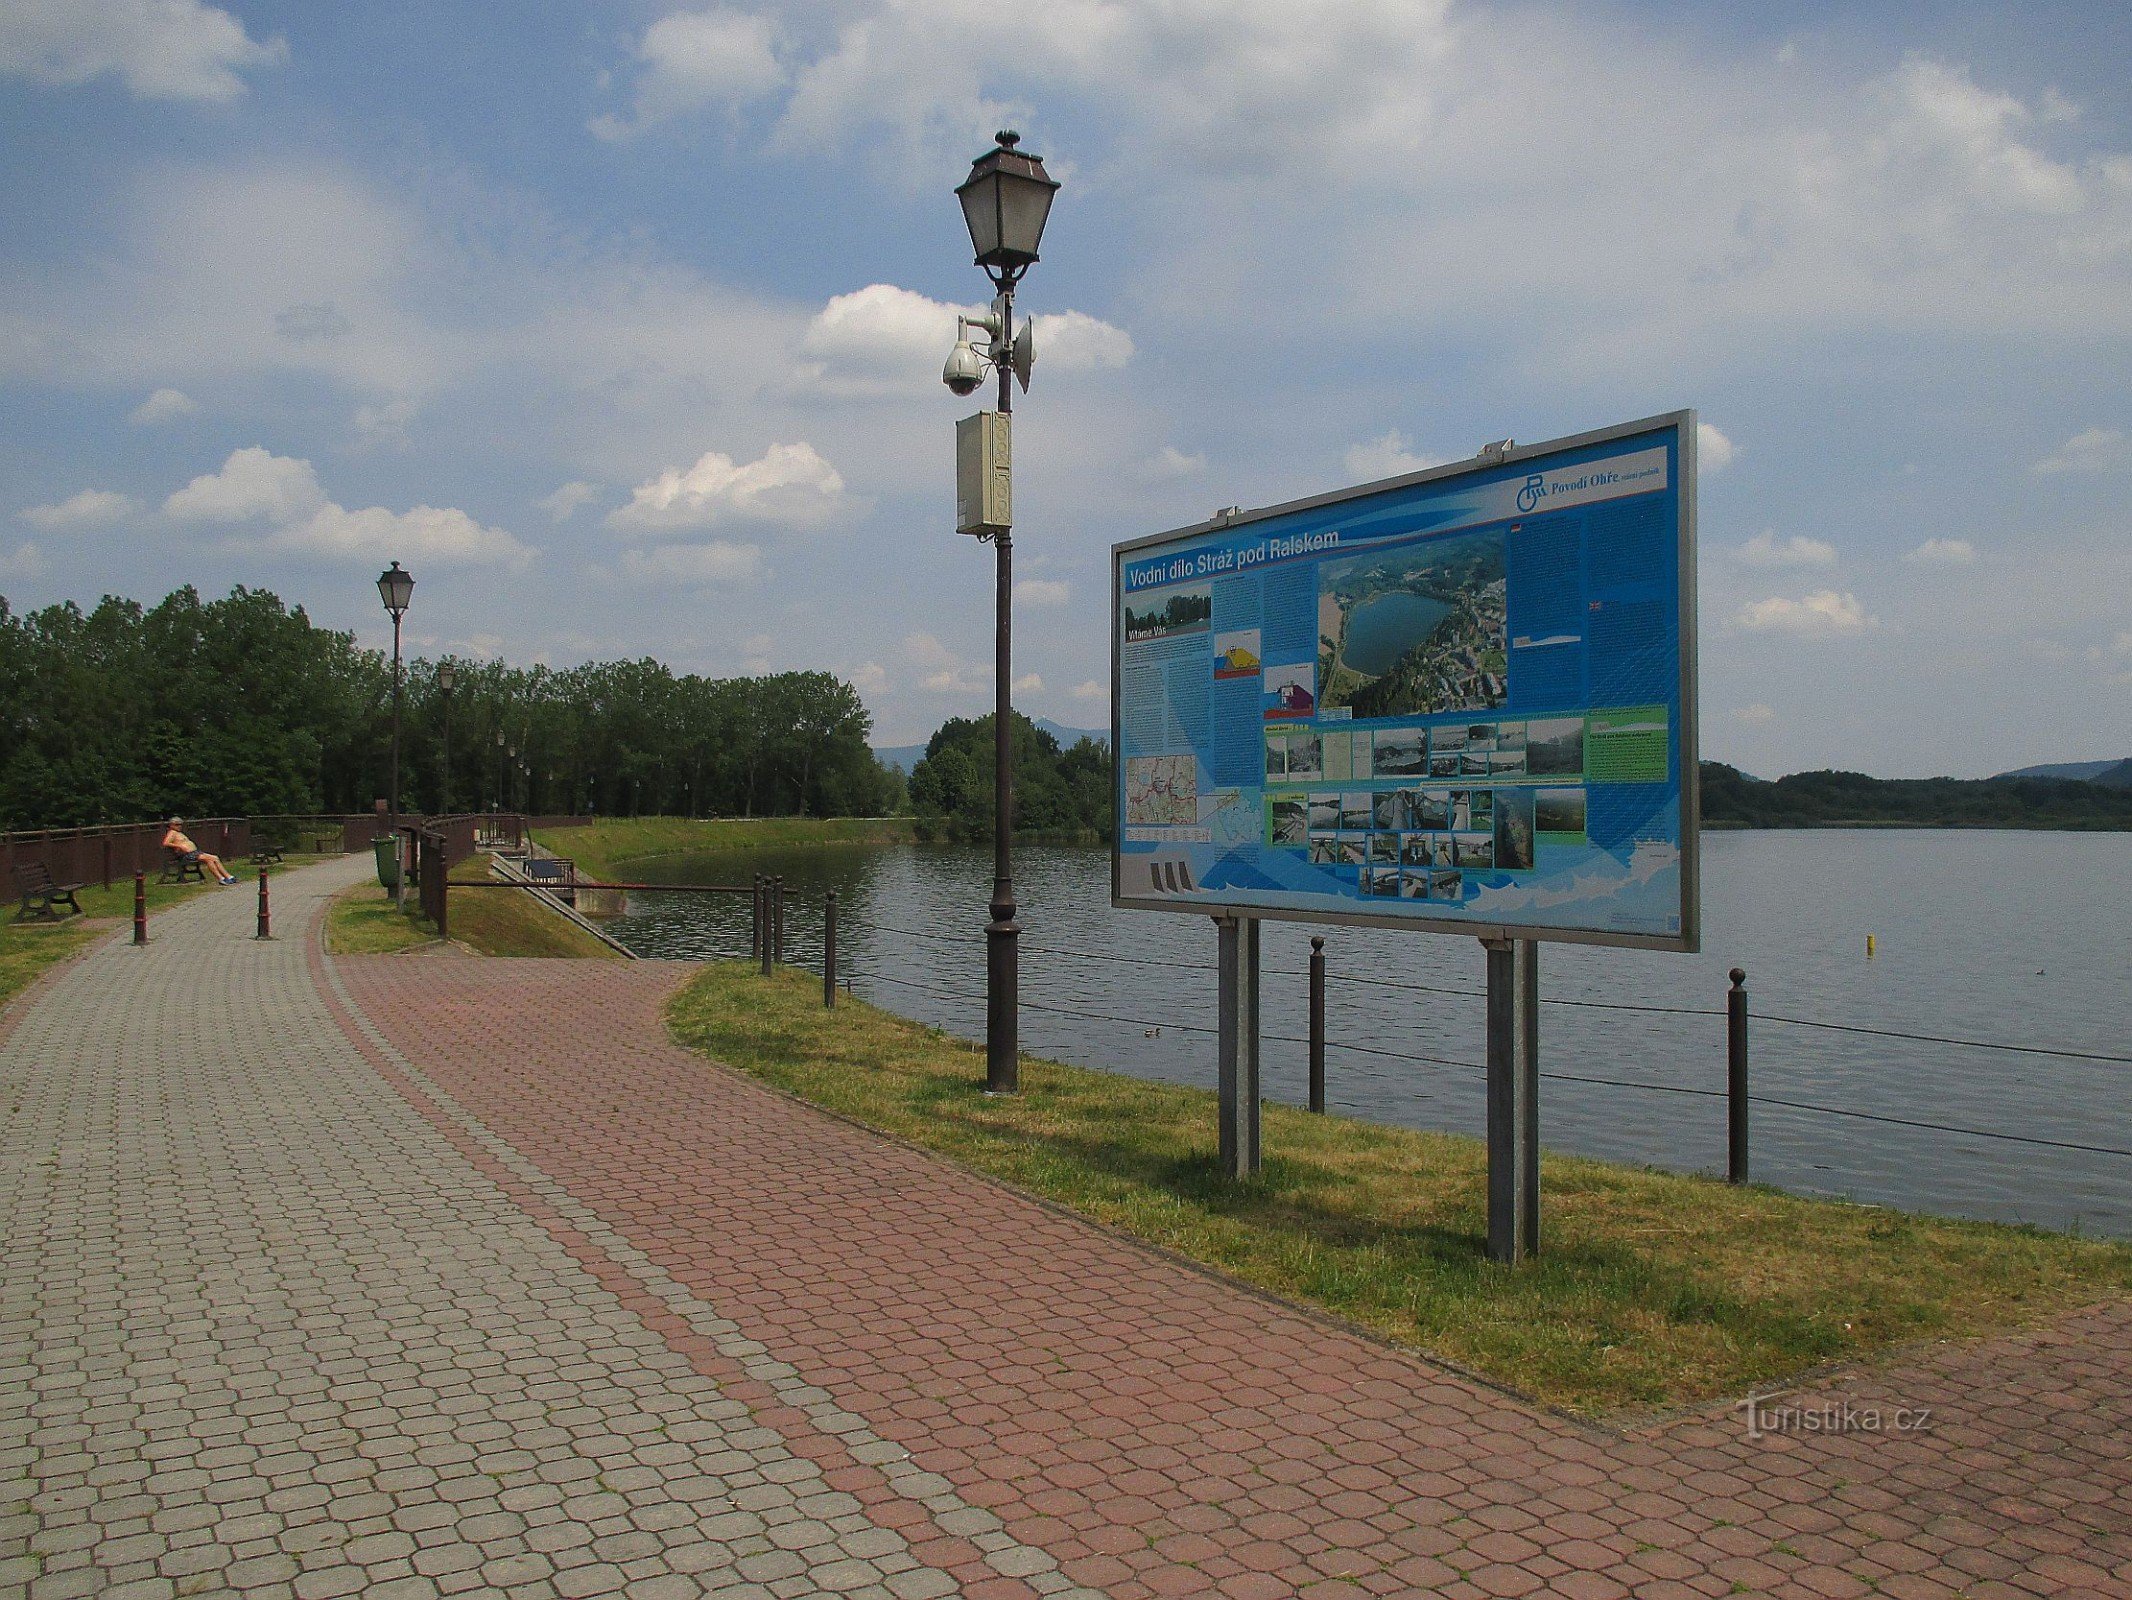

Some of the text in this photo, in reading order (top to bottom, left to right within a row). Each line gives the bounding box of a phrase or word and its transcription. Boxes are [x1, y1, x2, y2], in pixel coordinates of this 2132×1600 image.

[1552, 477, 1587, 495] Povodí
[1590, 472, 1619, 487] Ohře
[1169, 558, 1193, 580] dílo
[1197, 548, 1233, 574] Stráž
[1237, 541, 1265, 570] pod
[1270, 531, 1339, 559] Ralskem
